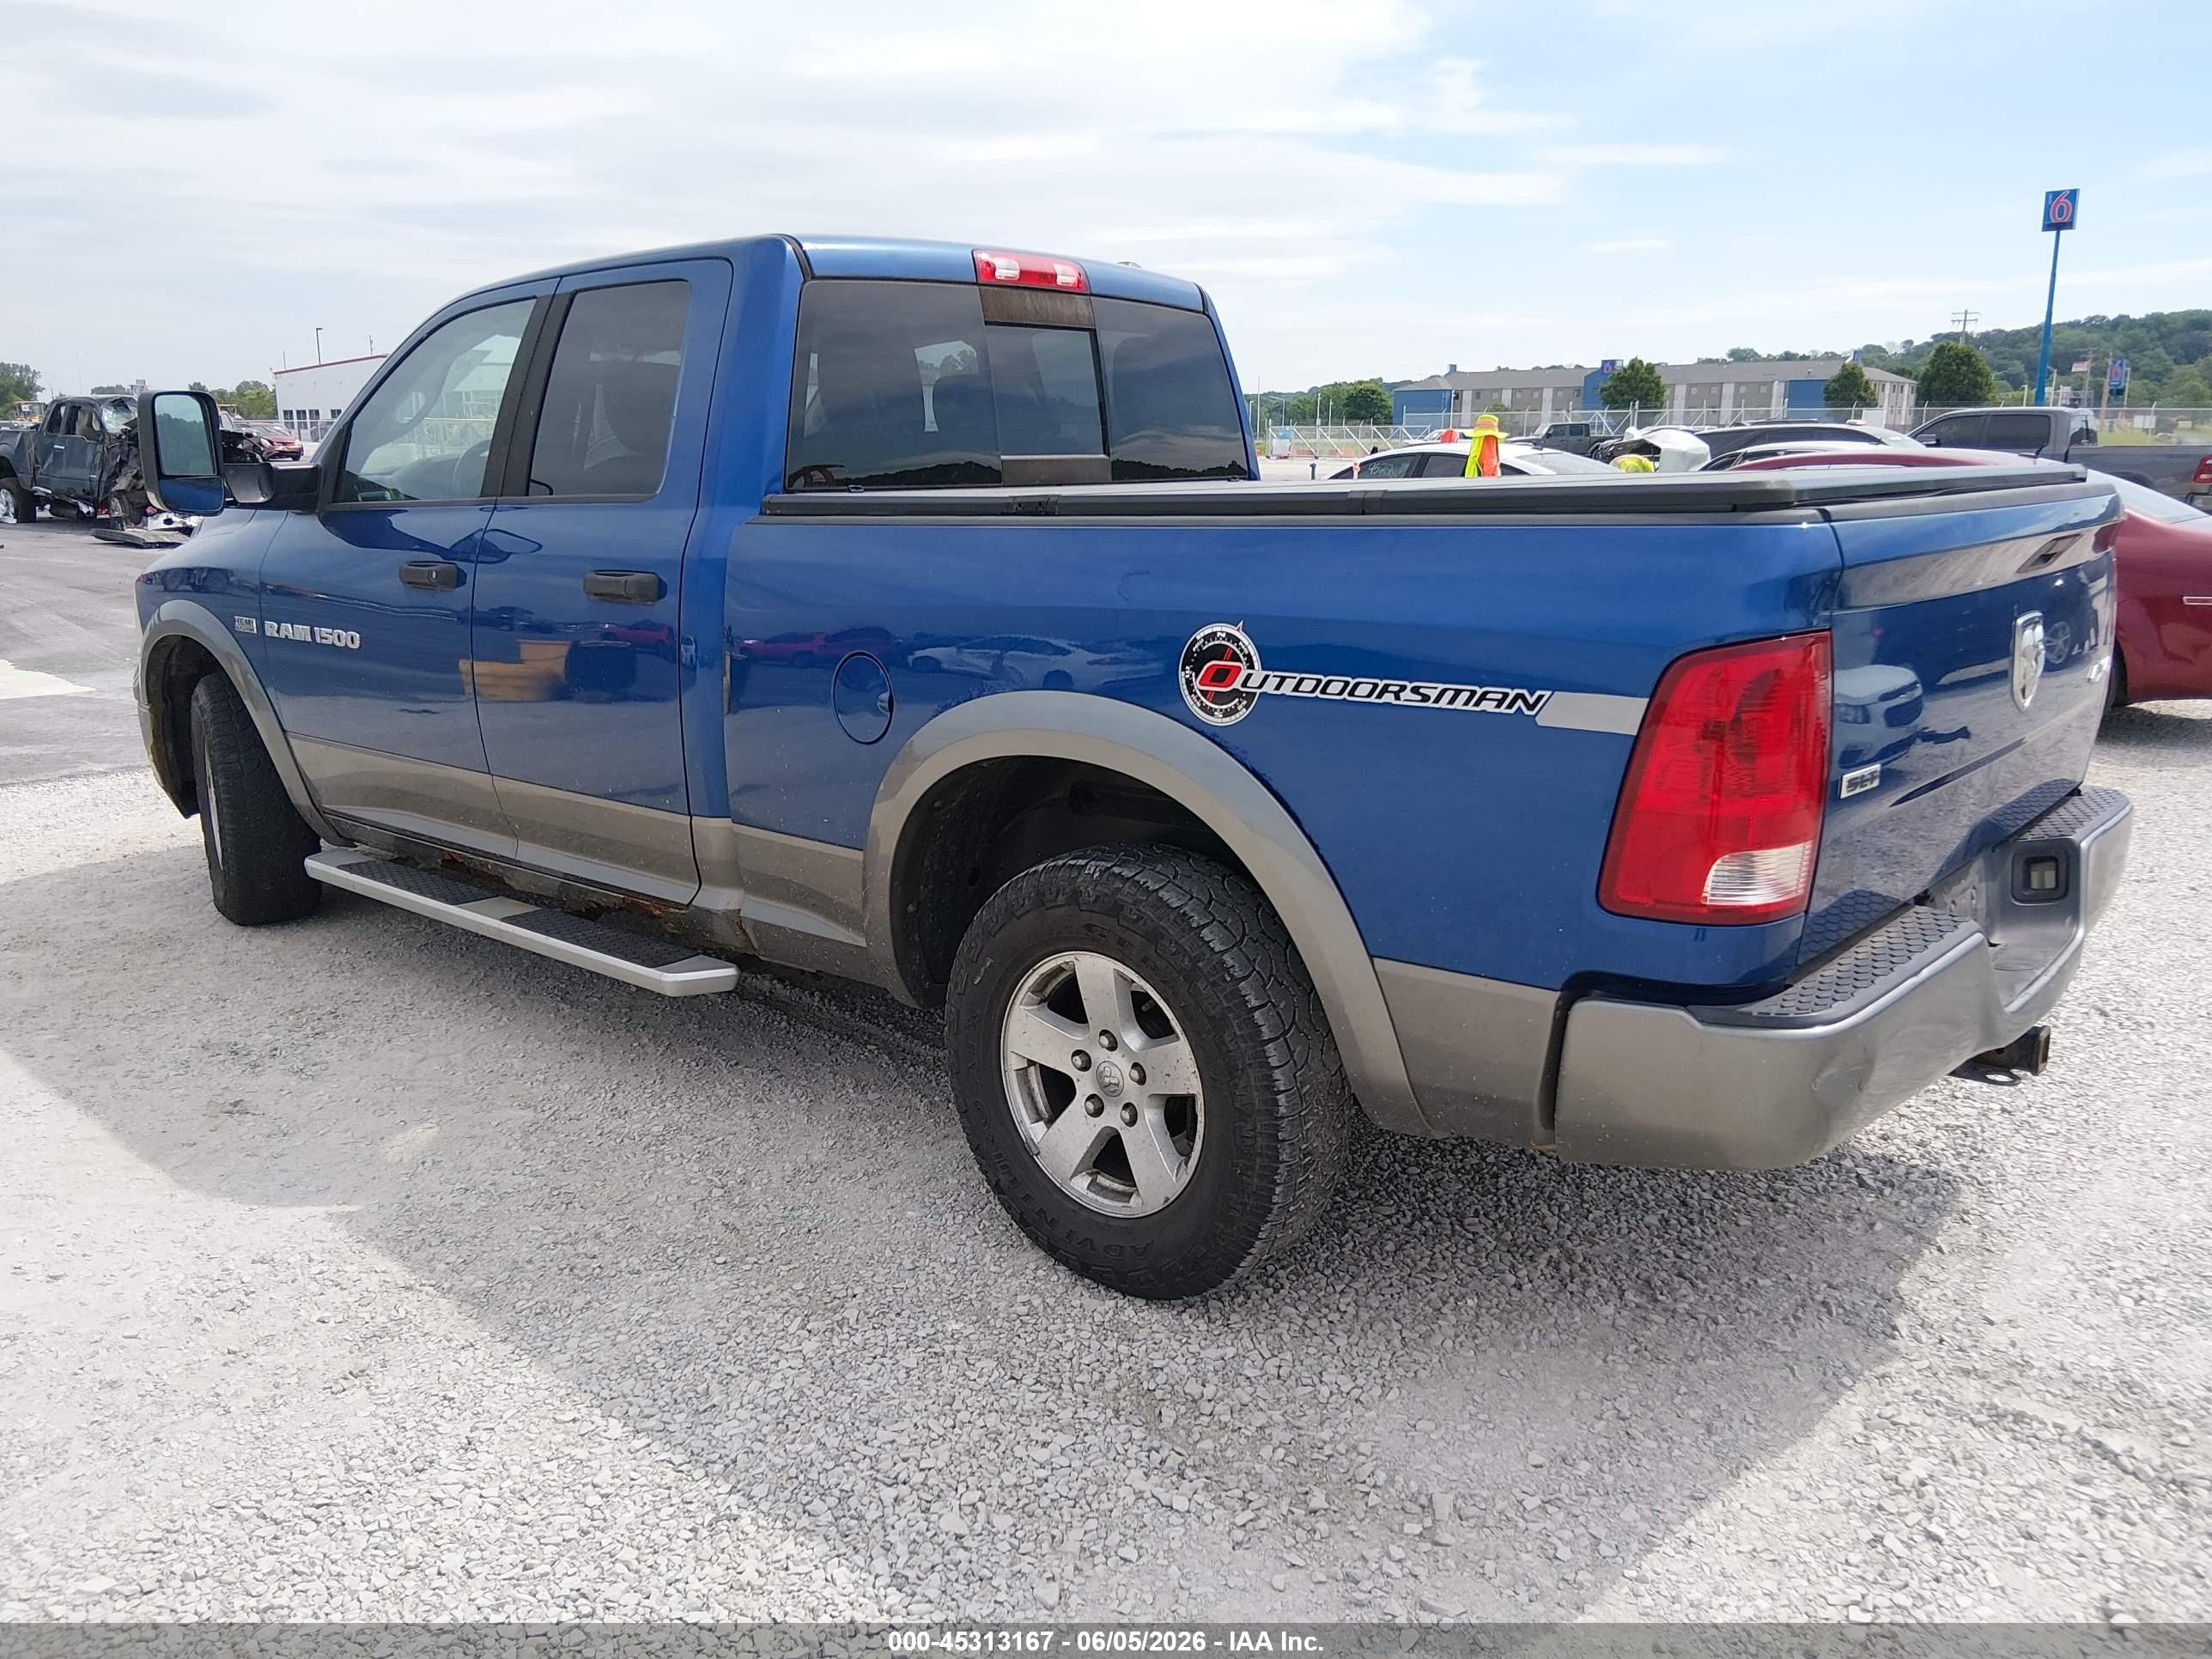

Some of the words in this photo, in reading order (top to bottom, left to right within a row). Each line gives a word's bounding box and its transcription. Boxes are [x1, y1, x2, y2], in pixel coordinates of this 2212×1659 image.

[2050, 190, 2072, 222] 6
[264, 621, 312, 641] RAM
[313, 627, 361, 649] 1500
[1197, 661, 1548, 713] OUTDOORSMAN
